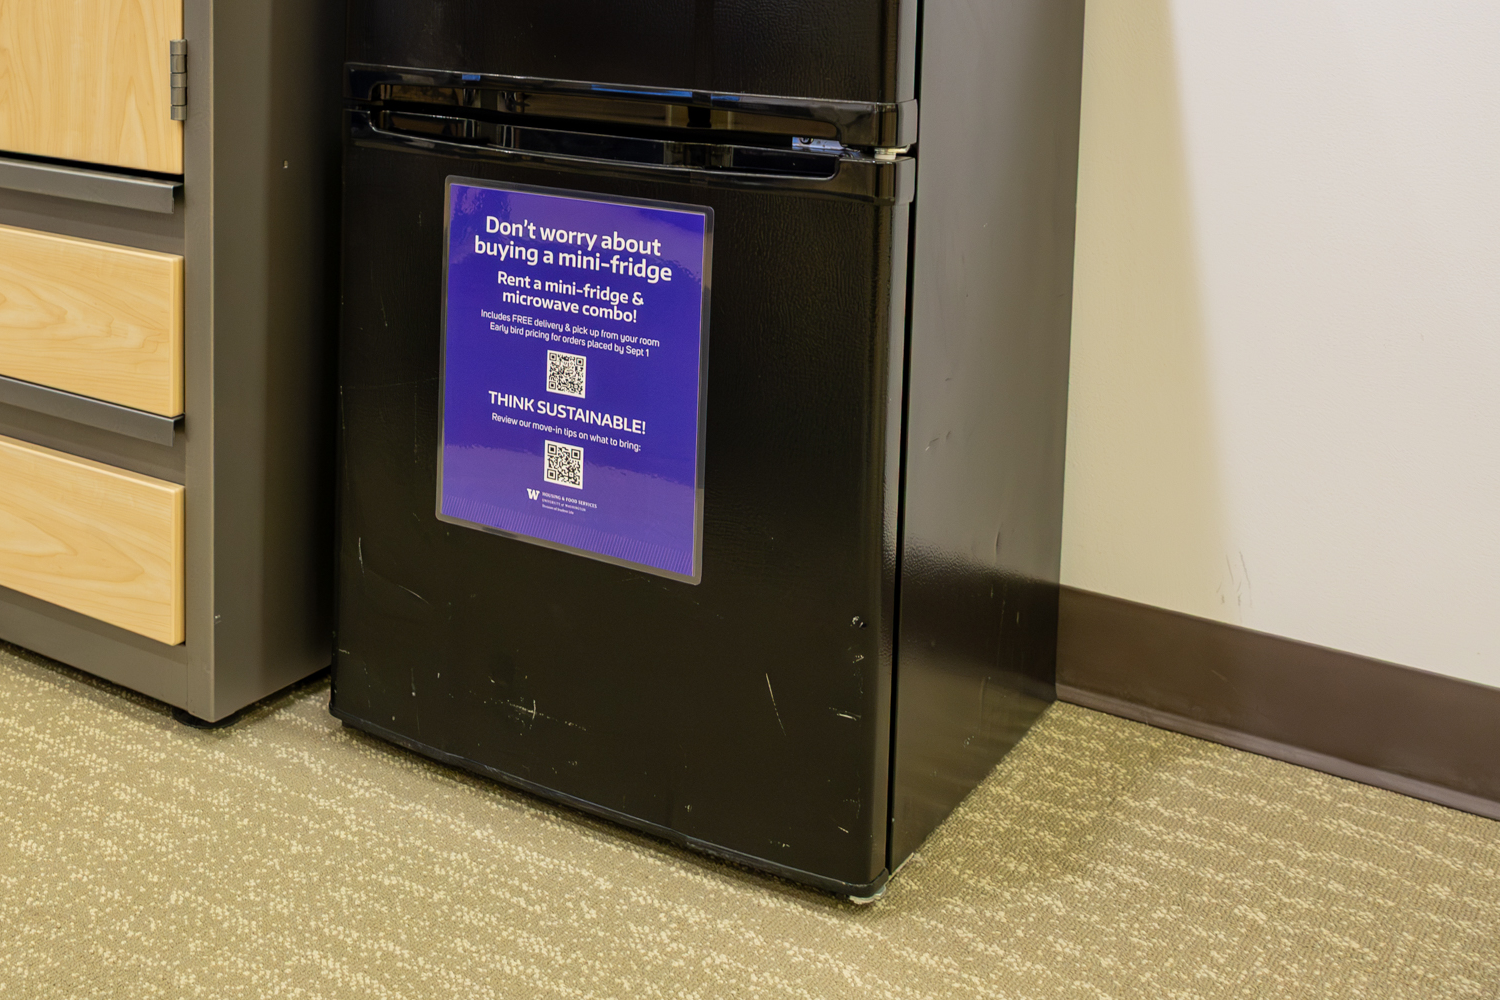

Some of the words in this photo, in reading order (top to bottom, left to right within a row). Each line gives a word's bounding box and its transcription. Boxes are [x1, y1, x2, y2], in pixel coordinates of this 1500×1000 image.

[486, 215, 537, 239] Don't
[540, 226, 598, 250] worry
[600, 231, 662, 257] about
[474, 234, 539, 266] buying
[543, 250, 554, 265] a
[558, 251, 673, 284] mini-fridge
[497, 270, 531, 289] Rent
[533, 279, 542, 290] a
[545, 279, 629, 306] mini-fridge
[631, 291, 644, 306] &
[502, 290, 580, 314] microwave
[582, 305, 638, 323] combo!
[480, 308, 511, 322] Includes
[512, 314, 533, 326] FREE
[533, 318, 564, 333] delivery
[564, 322, 571, 332] &
[572, 324, 589, 335] pick
[589, 328, 600, 338] up
[600, 329, 619, 340] from
[620, 334, 639, 344] your
[639, 337, 660, 348] room
[489, 321, 509, 335] Early
[510, 325, 524, 336] bird
[525, 328, 550, 342] pricing
[551, 332, 562, 342] for
[562, 335, 586, 346] orders
[587, 339, 613, 351] placed
[614, 343, 625, 355] by
[625, 345, 644, 357] Sept
[645, 348, 650, 358] 1
[488, 390, 535, 413] THINK
[537, 400, 646, 435] SUSTAINABLE!
[491, 412, 519, 426] Review
[518, 419, 532, 429] our
[532, 421, 563, 436] move-in
[563, 427, 578, 439] tips
[578, 431, 589, 441] on
[590, 433, 609, 445] what
[609, 437, 618, 446] to
[619, 438, 642, 453] bring:
[526, 488, 540, 501] W
[542, 491, 561, 501] HOUSING
[578, 499, 598, 509] SERVICES
